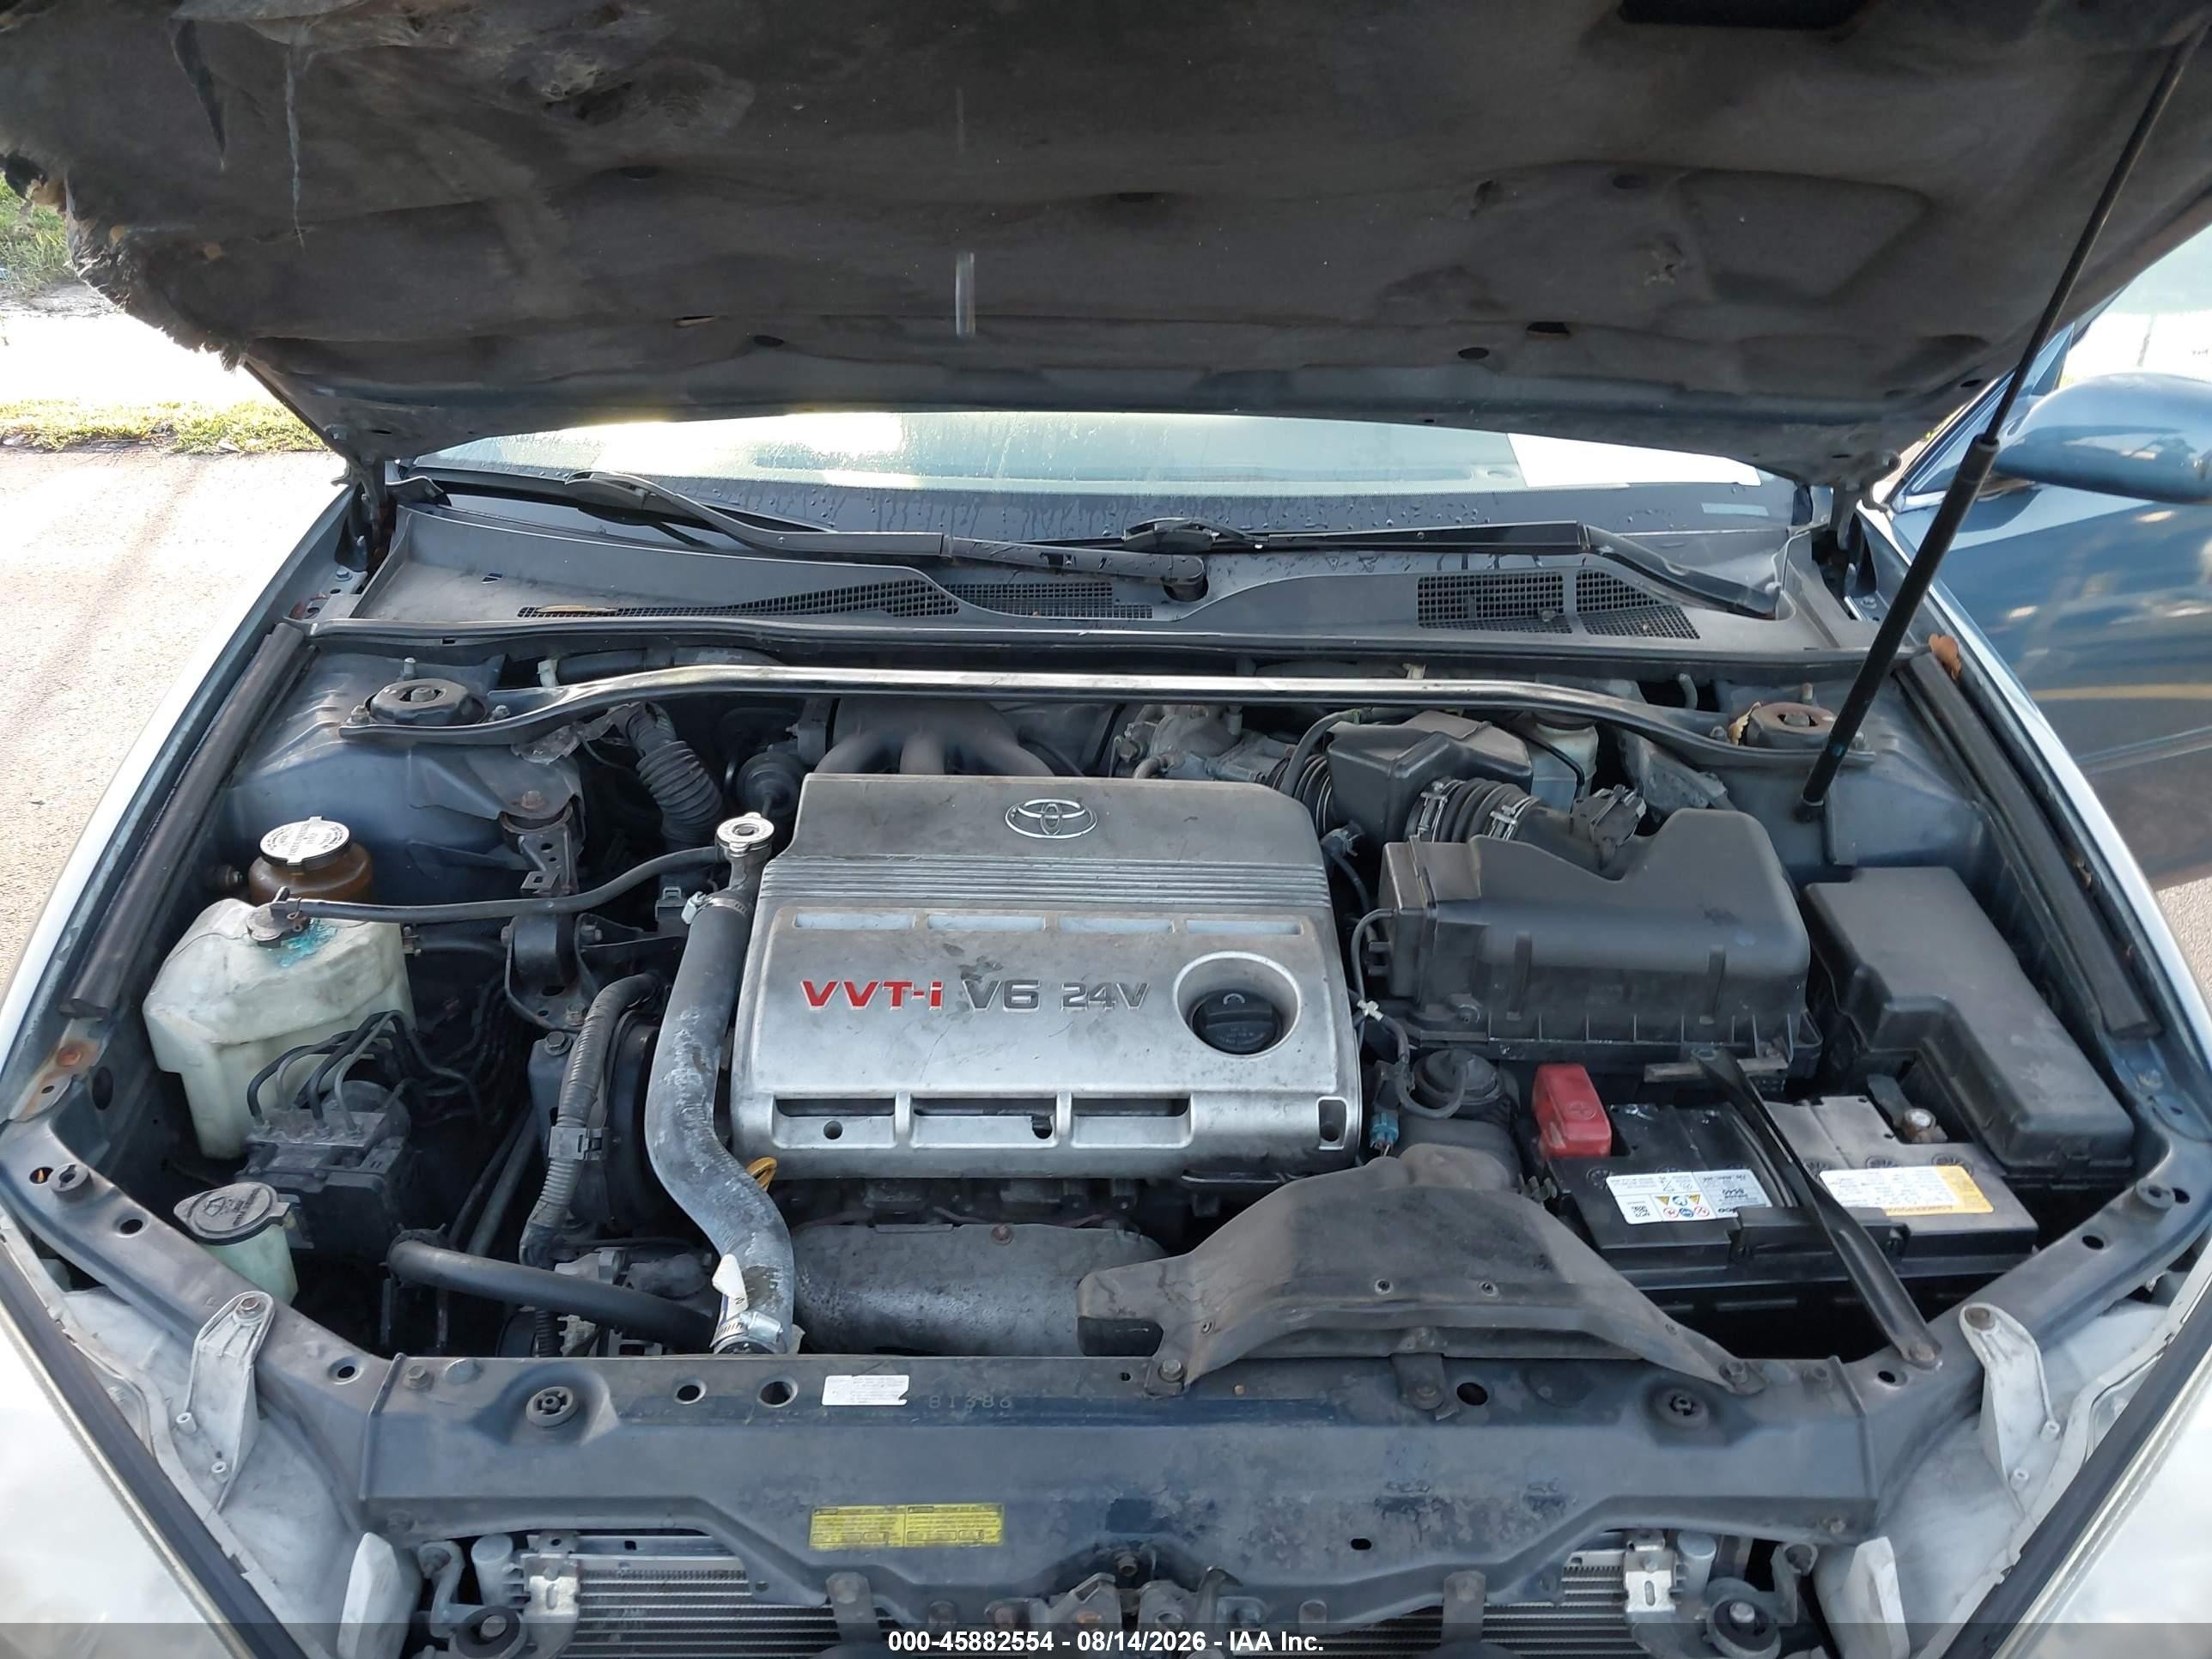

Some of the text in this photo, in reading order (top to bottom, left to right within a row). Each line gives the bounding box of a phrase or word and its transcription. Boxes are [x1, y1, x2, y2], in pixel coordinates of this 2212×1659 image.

[800, 979, 1150, 1012] VVT-i V6 24V
